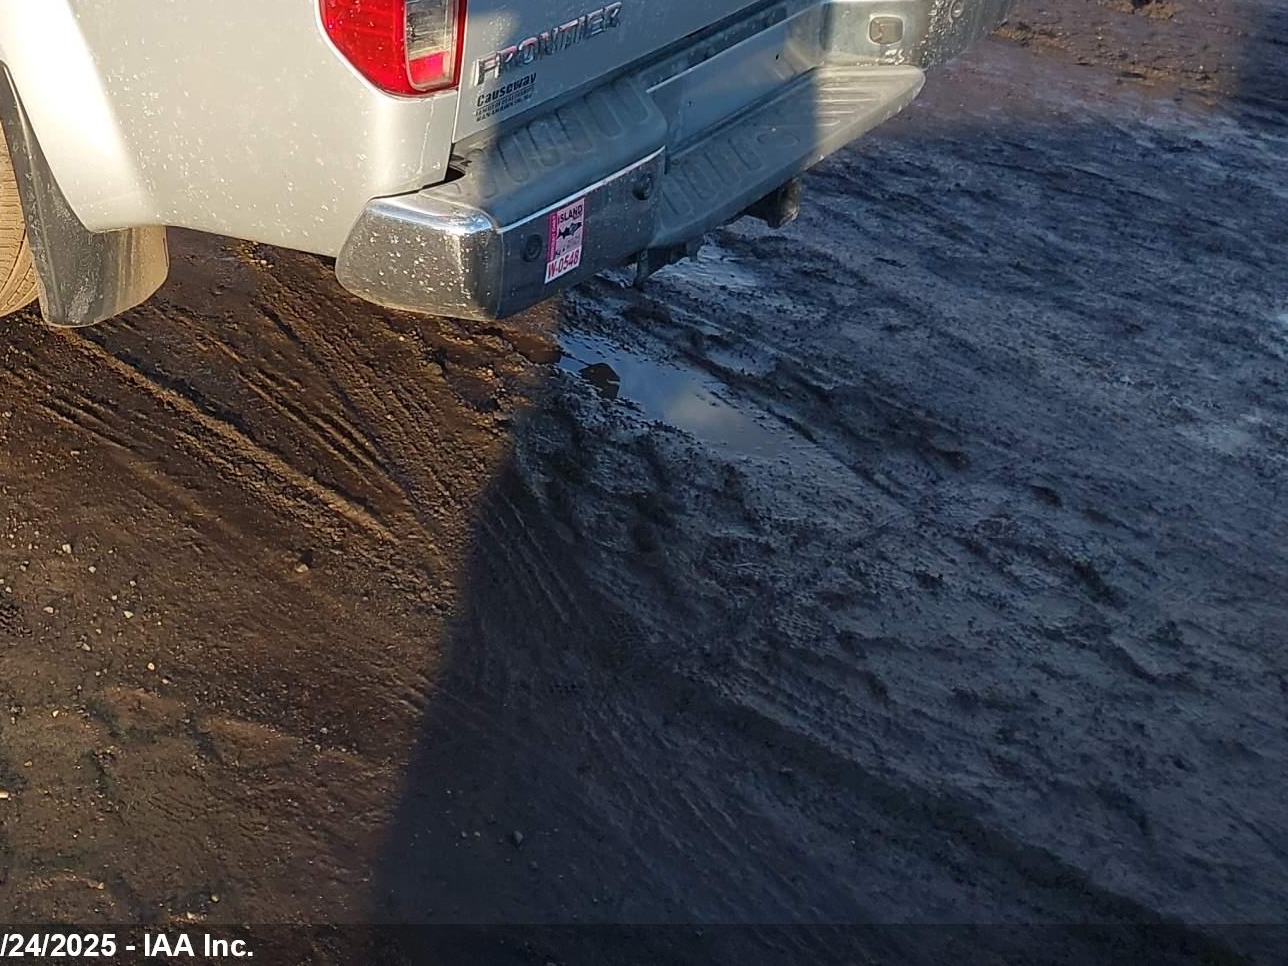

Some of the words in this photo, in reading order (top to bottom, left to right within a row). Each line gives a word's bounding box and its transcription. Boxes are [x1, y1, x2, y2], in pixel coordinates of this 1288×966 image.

[472, 1, 622, 87] FRONTIER
[476, 72, 537, 108] Causeway
[557, 204, 583, 225] ISLAND
